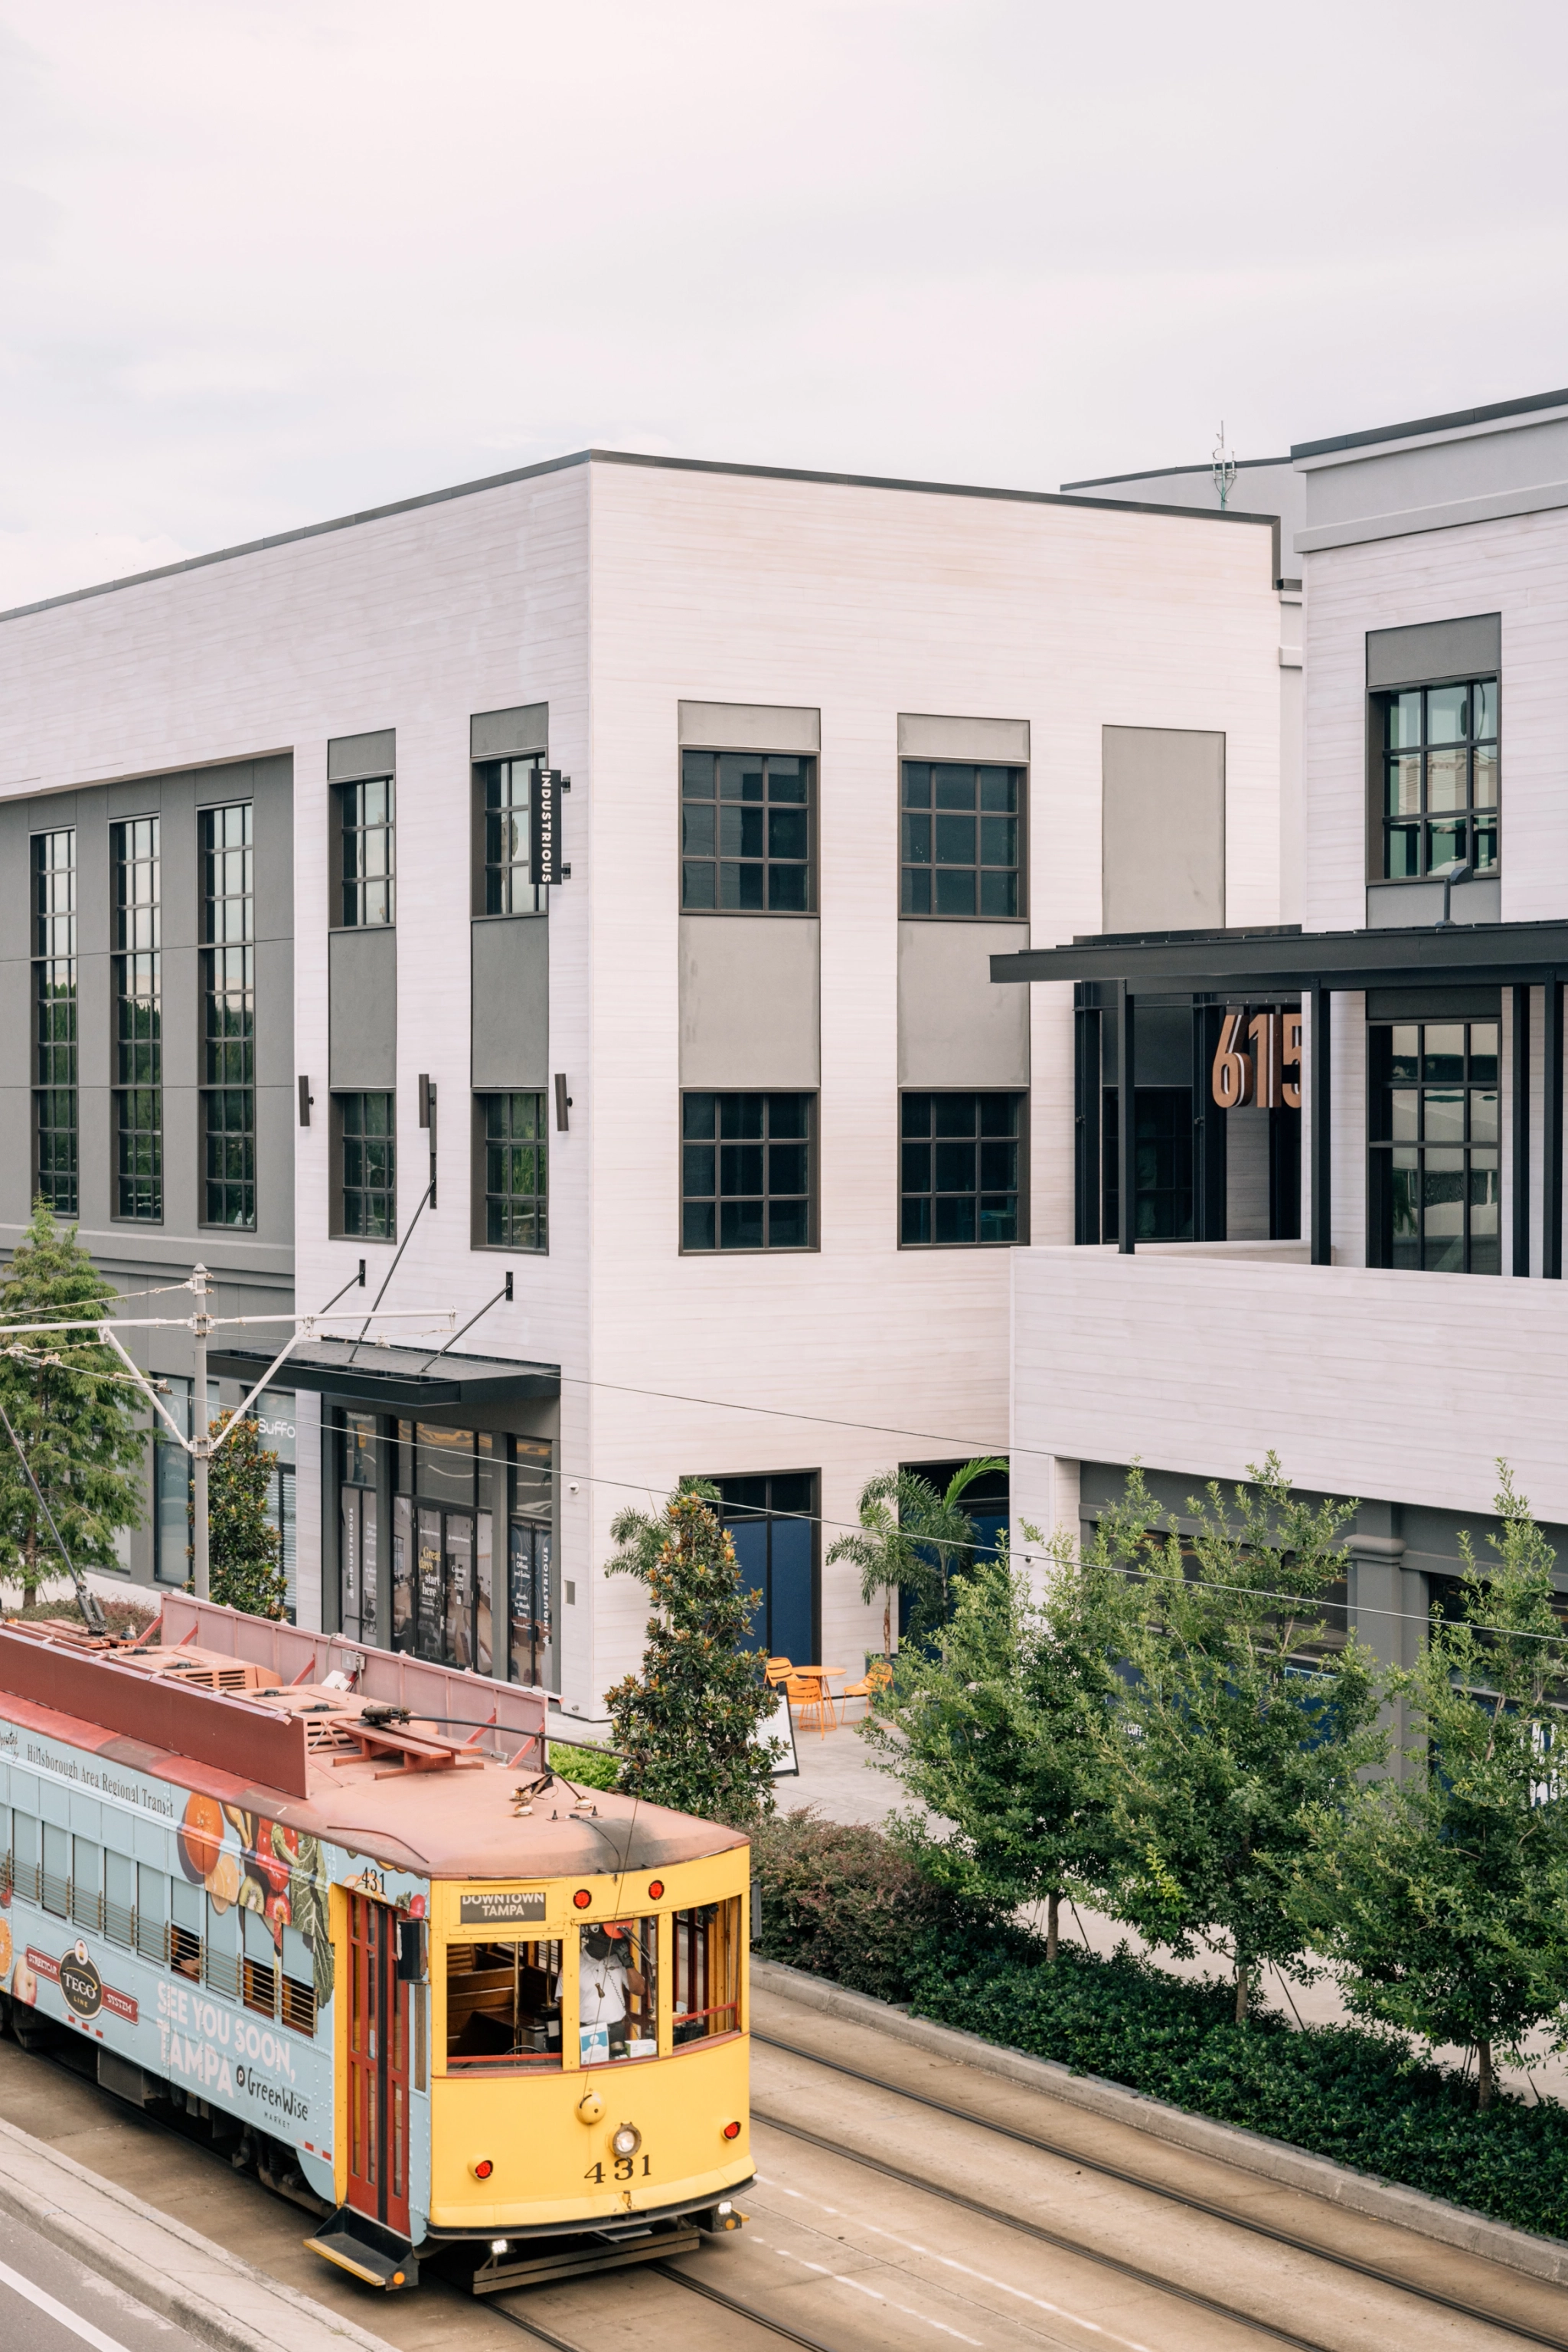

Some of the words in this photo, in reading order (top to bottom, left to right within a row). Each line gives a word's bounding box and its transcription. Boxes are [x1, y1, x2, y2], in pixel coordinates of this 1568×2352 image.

[541, 770, 551, 883] INDUSTRIOUS
[1212, 1013, 1302, 1109] 615
[419, 1556, 433, 1573] days
[423, 1546, 442, 1562] Great
[517, 1552, 528, 1561] Private
[451, 1564, 466, 1576] Coming
[516, 1560, 528, 1570] Offices
[422, 1582, 437, 1596] here
[425, 1573, 440, 1586] start
[0, 1730, 18, 1751] perated
[28, 1743, 78, 1782] Hillsborough
[81, 1765, 100, 1788] Area
[102, 1772, 139, 1804] Regional
[142, 1788, 174, 1818] Transit
[361, 1867, 386, 1896] 431
[462, 1893, 545, 1906] DOWNTOWN
[482, 1904, 524, 1916] TAMPA
[28, 1952, 58, 1976] STREETCAR
[63, 1971, 97, 2000] TECO
[73, 1995, 89, 2008] LINE
[106, 1993, 132, 2014] SYSTEM
[157, 1981, 188, 2026] SEE
[192, 1996, 230, 2046] YOU
[234, 2018, 296, 2084] SOON,
[156, 2017, 234, 2099] TAMPA
[247, 2066, 309, 2122] GreenWise
[264, 2111, 290, 2130] MARKET
[583, 2154, 652, 2185] 431
